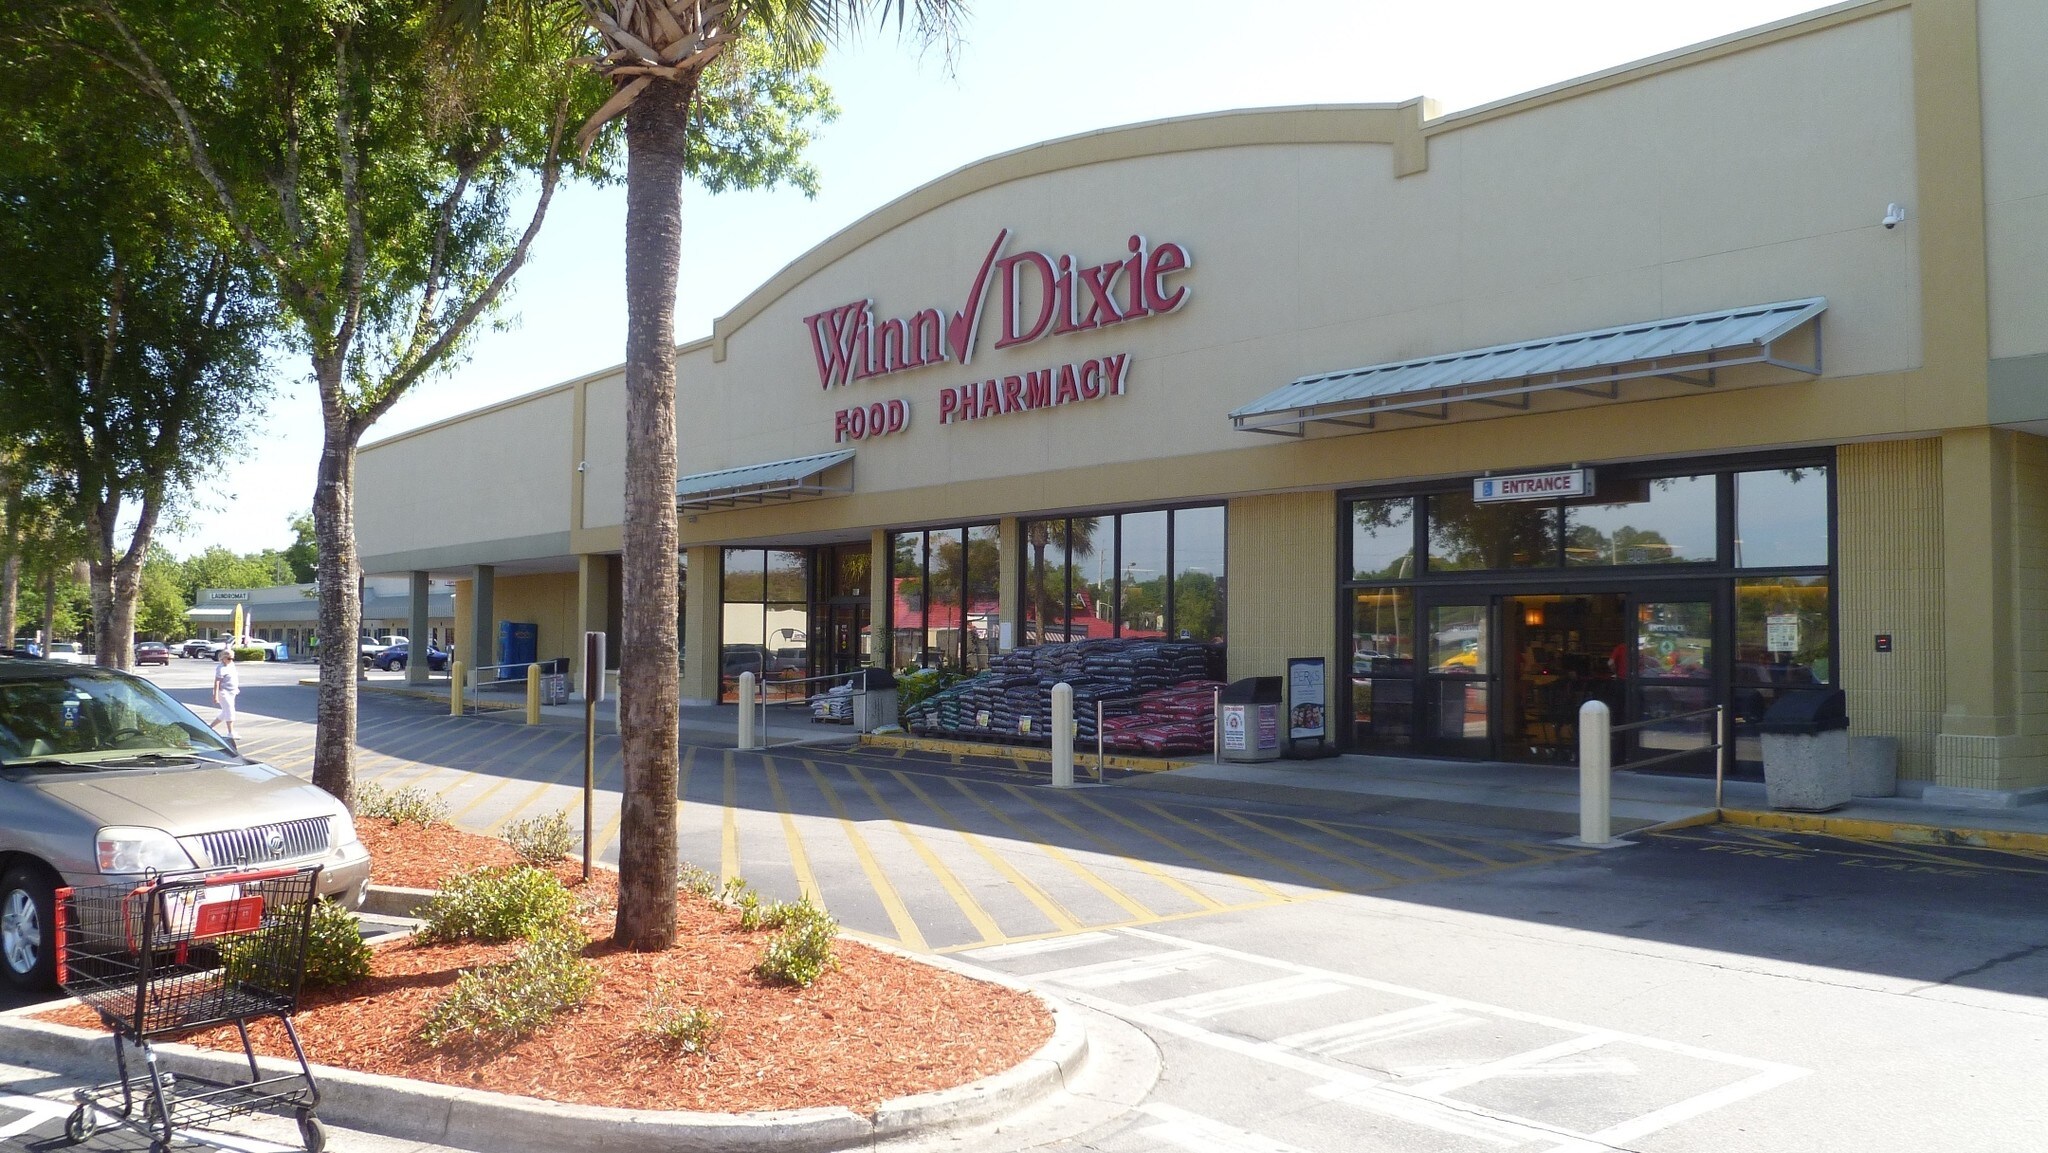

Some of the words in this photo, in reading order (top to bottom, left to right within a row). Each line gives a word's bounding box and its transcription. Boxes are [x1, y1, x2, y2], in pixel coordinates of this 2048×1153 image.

[802, 298, 949, 391] Winn
[994, 234, 1191, 350] Dixie
[834, 399, 911, 443] FOOD
[939, 353, 1132, 425] PHARMACY
[1501, 475, 1571, 495] ENTRANCE
